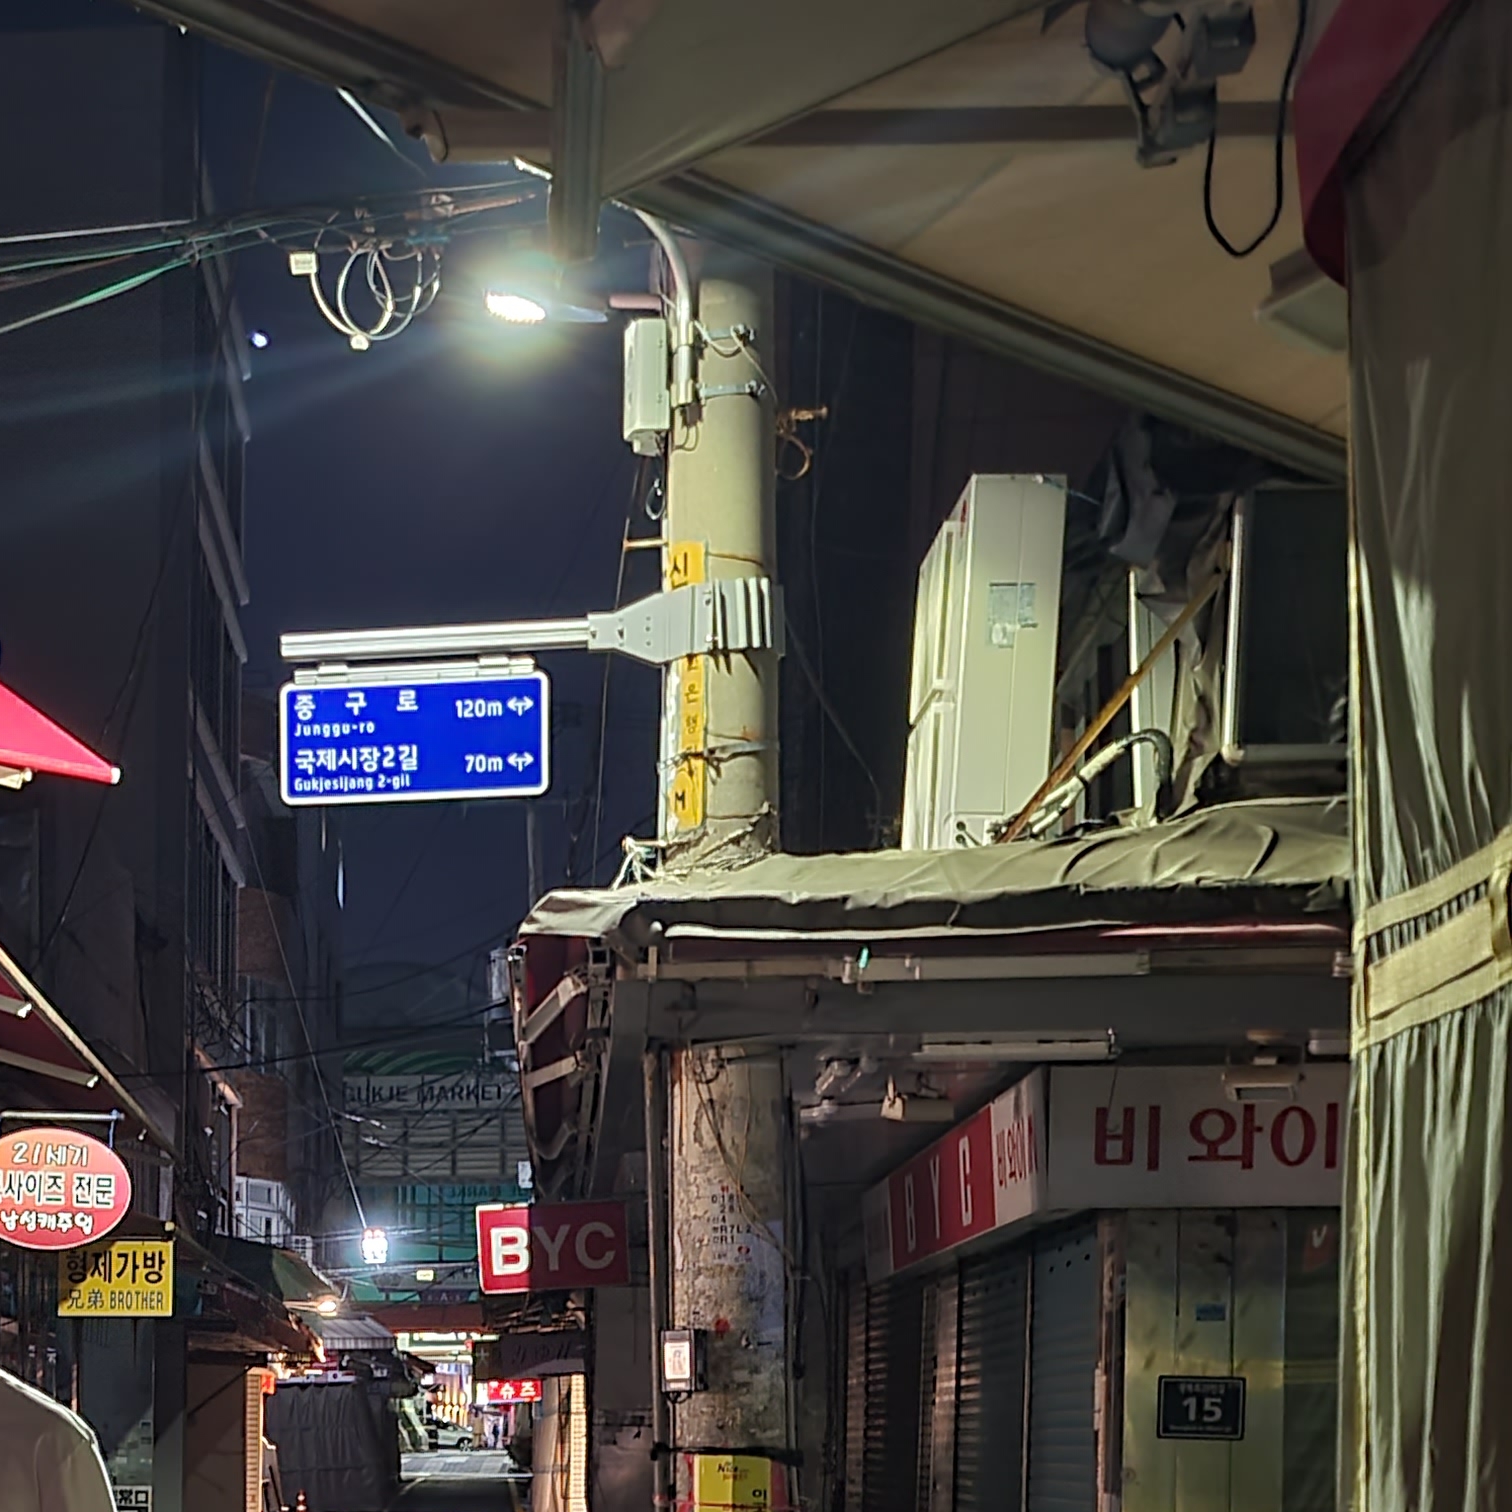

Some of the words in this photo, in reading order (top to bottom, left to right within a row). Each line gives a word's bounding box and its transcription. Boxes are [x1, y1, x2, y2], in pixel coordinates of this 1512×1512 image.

[455, 698, 503, 718] 120m
[294, 721, 376, 738] Junggu-ro
[294, 744, 419, 776] 국제시장2길
[464, 754, 503, 774] 70m
[294, 775, 373, 793] Gukjesijang
[417, 1084, 503, 1102] MARKET
[11, 1141, 89, 1168] 21세기
[72, 1172, 115, 1209] 전문
[904, 1135, 973, 1253] BYC
[490, 1220, 616, 1277] BYC
[67, 1249, 166, 1285] 형제가방
[109, 1291, 164, 1310] BROTHER
[1181, 1395, 1223, 1423] 15
